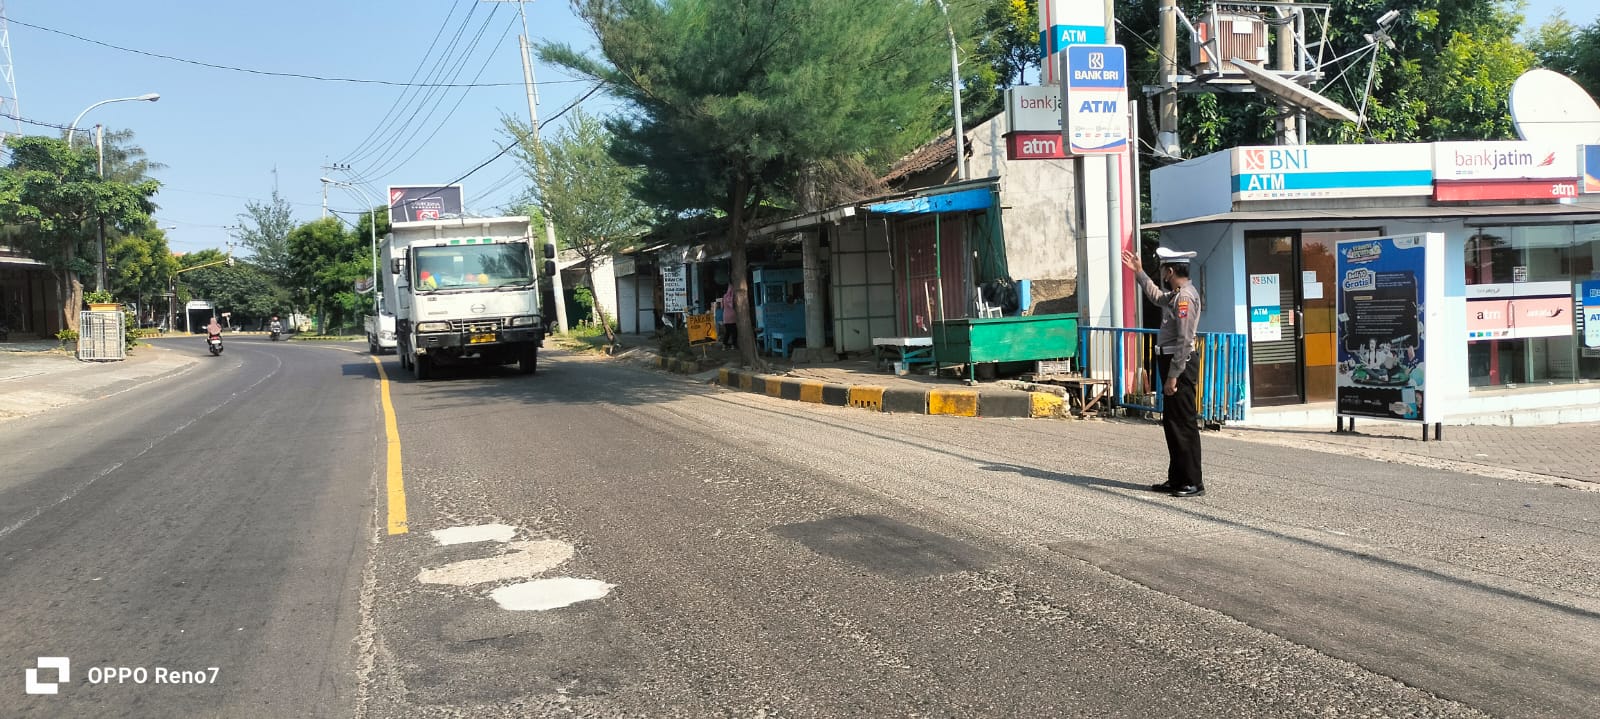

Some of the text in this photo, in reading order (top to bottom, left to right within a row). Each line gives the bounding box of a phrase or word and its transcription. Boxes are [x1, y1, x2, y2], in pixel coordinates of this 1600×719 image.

[1061, 30, 1087, 42] ATM
[1074, 70, 1119, 80] BANK BRI
[1020, 95, 1062, 112] bankja
[1079, 101, 1117, 113] ATM
[1023, 138, 1056, 154] atm
[1270, 149, 1309, 169] BNI
[1455, 149, 1533, 170] bankjatim
[1247, 174, 1285, 190] ATM
[1552, 183, 1575, 196] atm
[1260, 275, 1276, 285] BNI
[1345, 279, 1368, 289] Gratis
[1253, 308, 1268, 316] ATM
[1477, 308, 1501, 320] atm
